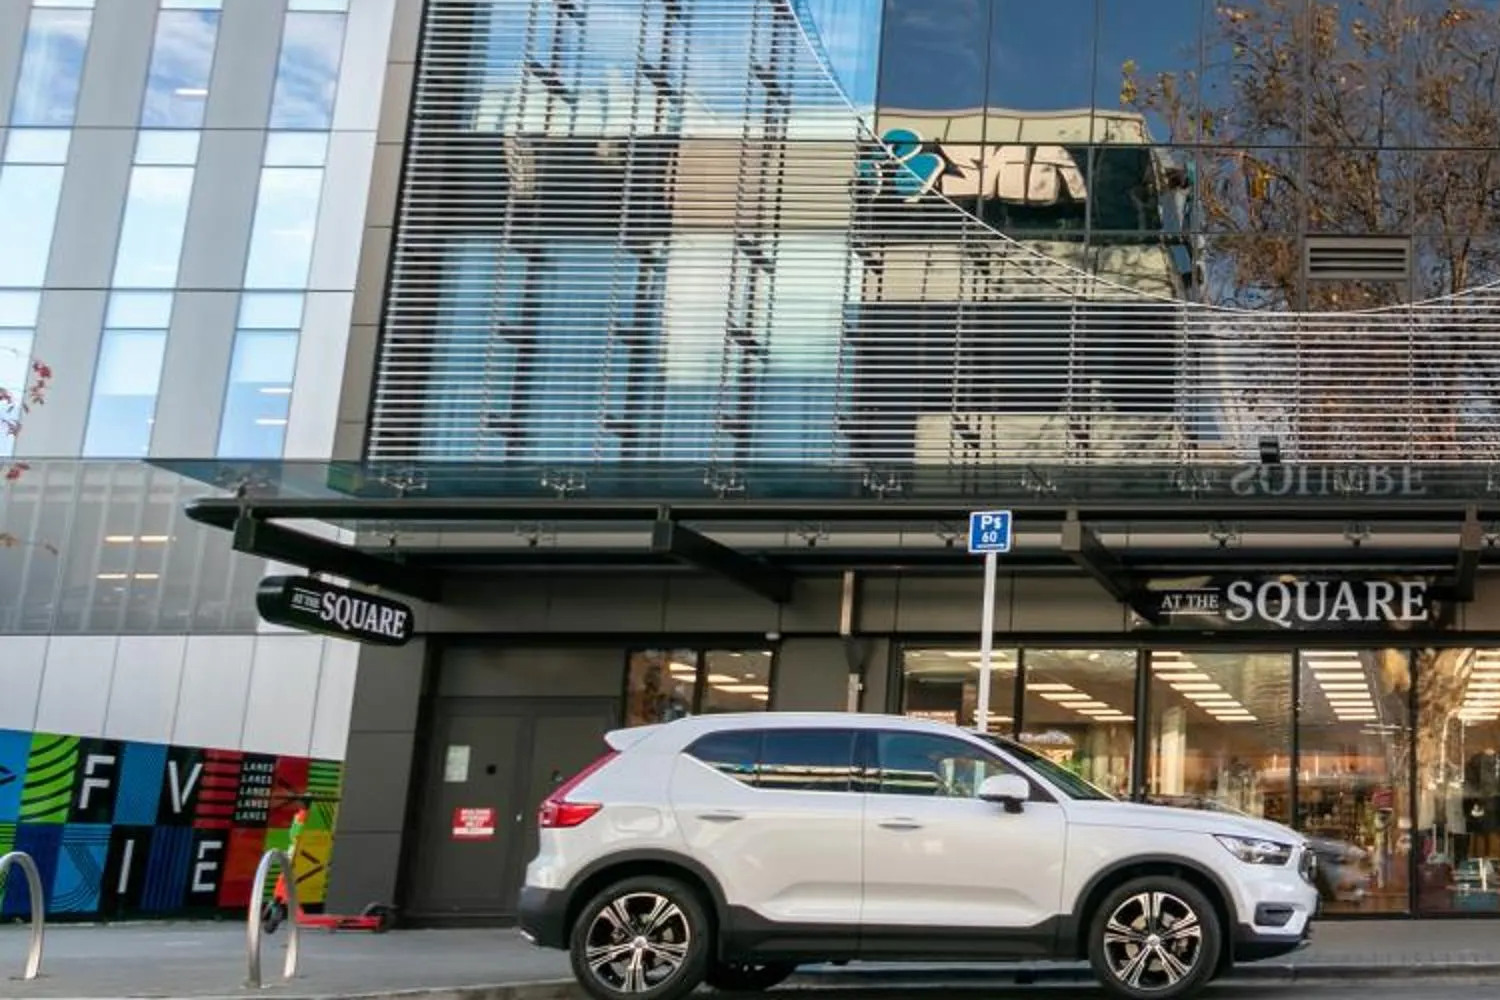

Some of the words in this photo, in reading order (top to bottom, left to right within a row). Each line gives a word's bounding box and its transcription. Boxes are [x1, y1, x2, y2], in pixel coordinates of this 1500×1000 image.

[981, 530, 998, 543] 60
[319, 591, 408, 639] SQUARE
[1161, 594, 1182, 609] AT
[1185, 594, 1219, 609] THE
[1225, 580, 1428, 629] SQUARE
